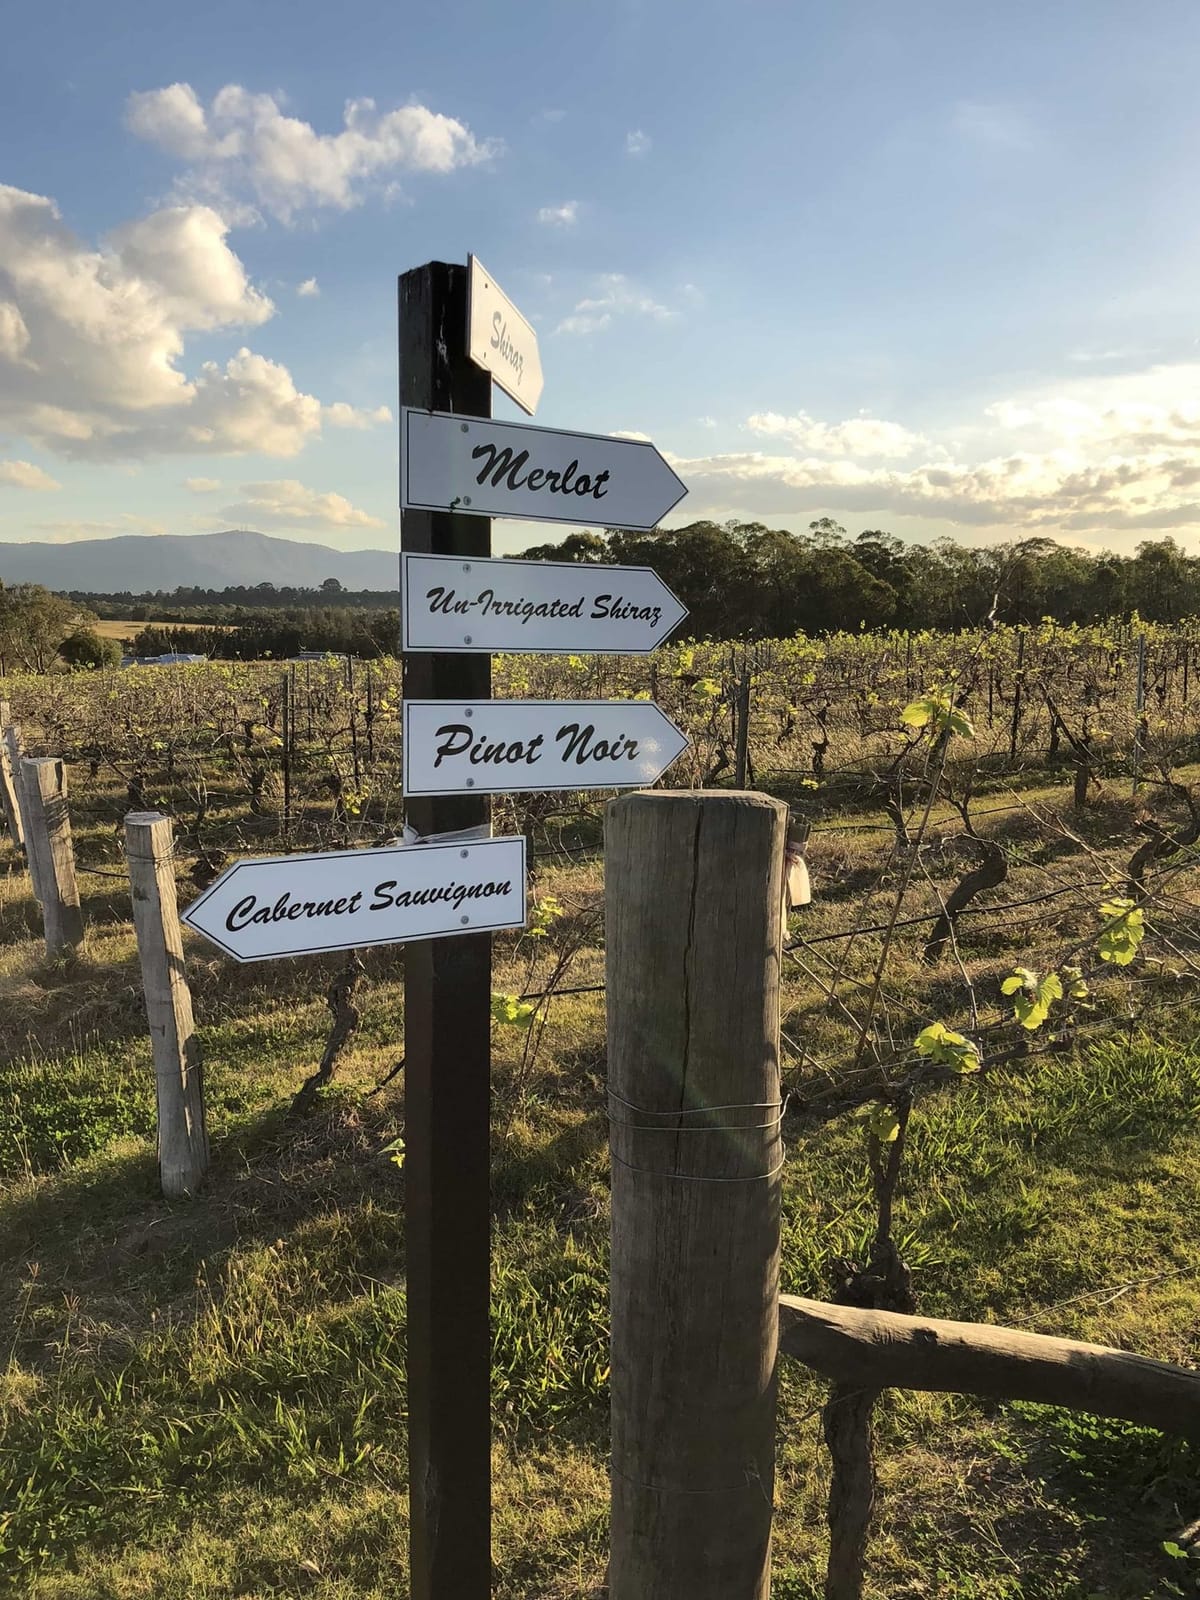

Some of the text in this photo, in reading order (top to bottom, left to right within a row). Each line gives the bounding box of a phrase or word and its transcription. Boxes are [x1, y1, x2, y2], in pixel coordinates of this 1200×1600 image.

[490, 311, 525, 385] Shiraz
[471, 443, 610, 499] Merlot
[426, 587, 663, 627] Un-Irrigated Shiraz
[434, 723, 640, 768] Pinot Noir
[225, 880, 513, 932] Cabernet Sauvignon
